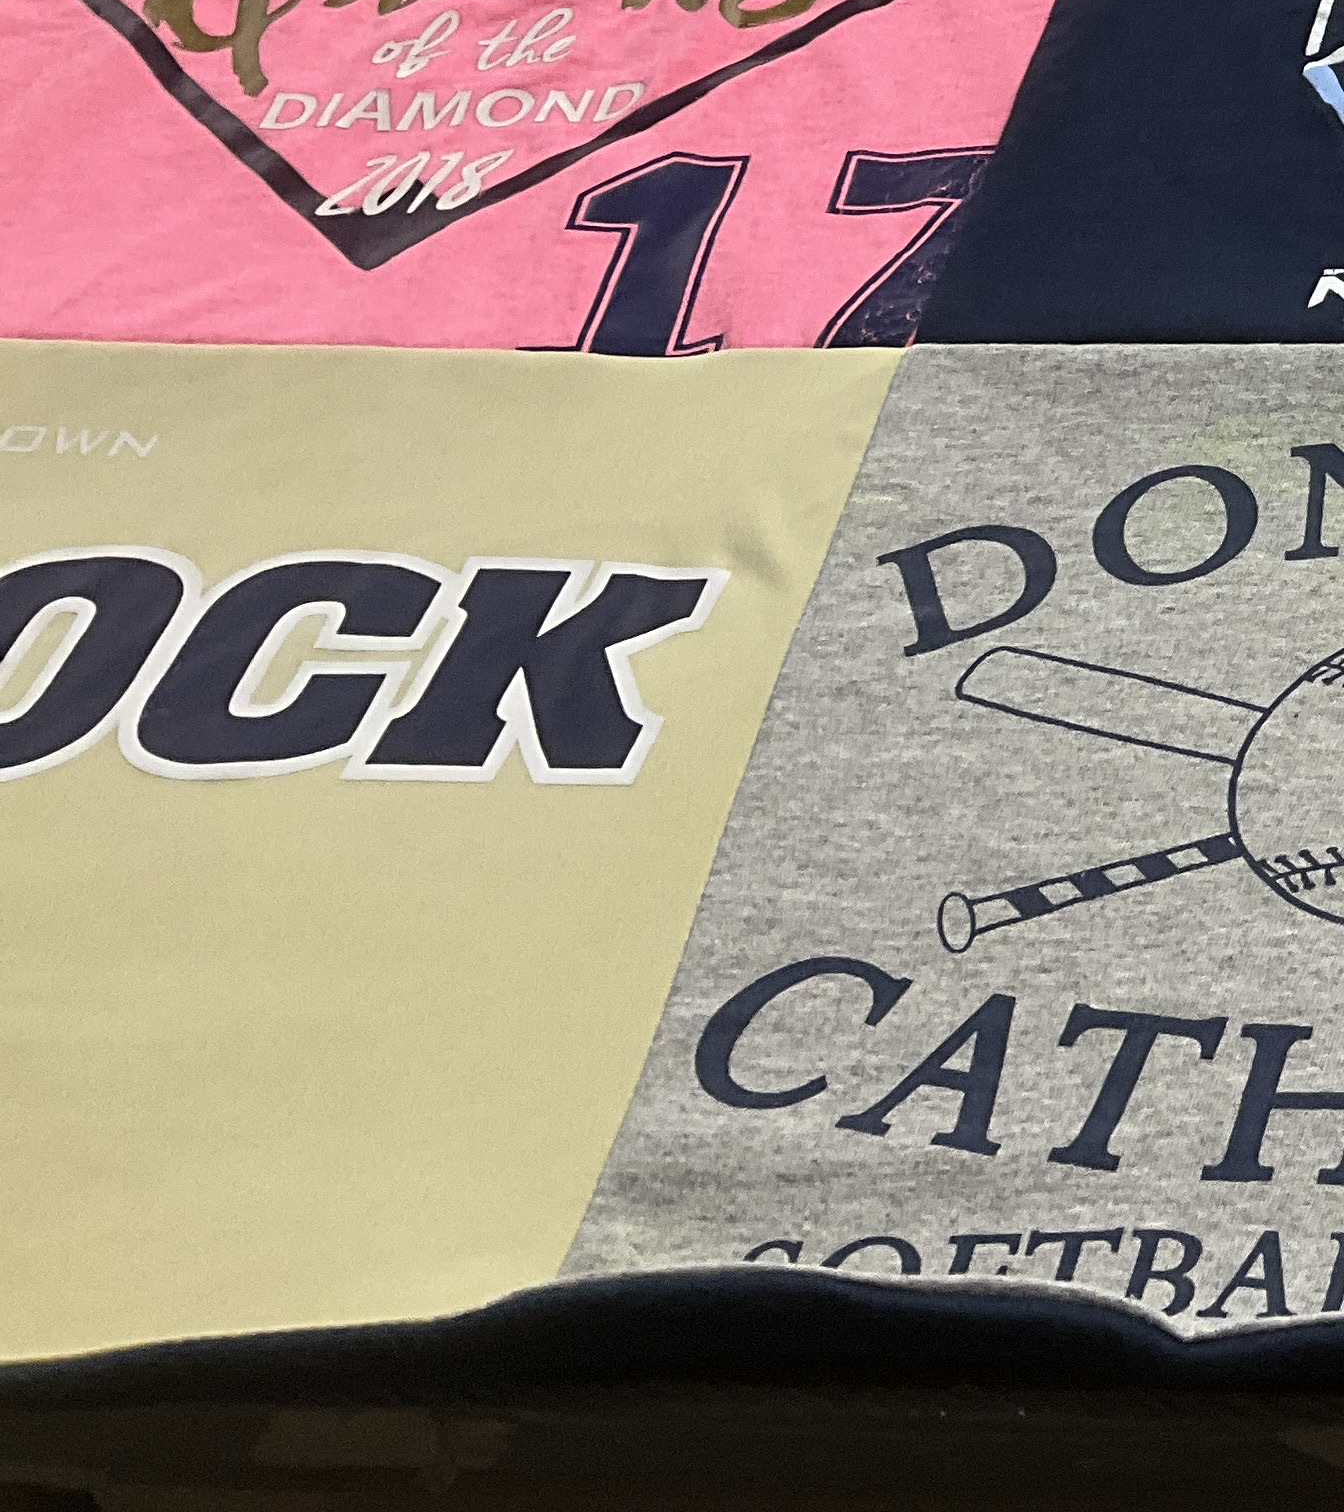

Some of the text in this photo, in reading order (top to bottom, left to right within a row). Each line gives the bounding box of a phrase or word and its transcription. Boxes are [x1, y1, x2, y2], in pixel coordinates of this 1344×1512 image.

[370, 5, 580, 80] of the
[259, 79, 649, 134] DIAMOND
[314, 148, 516, 217] 2018
